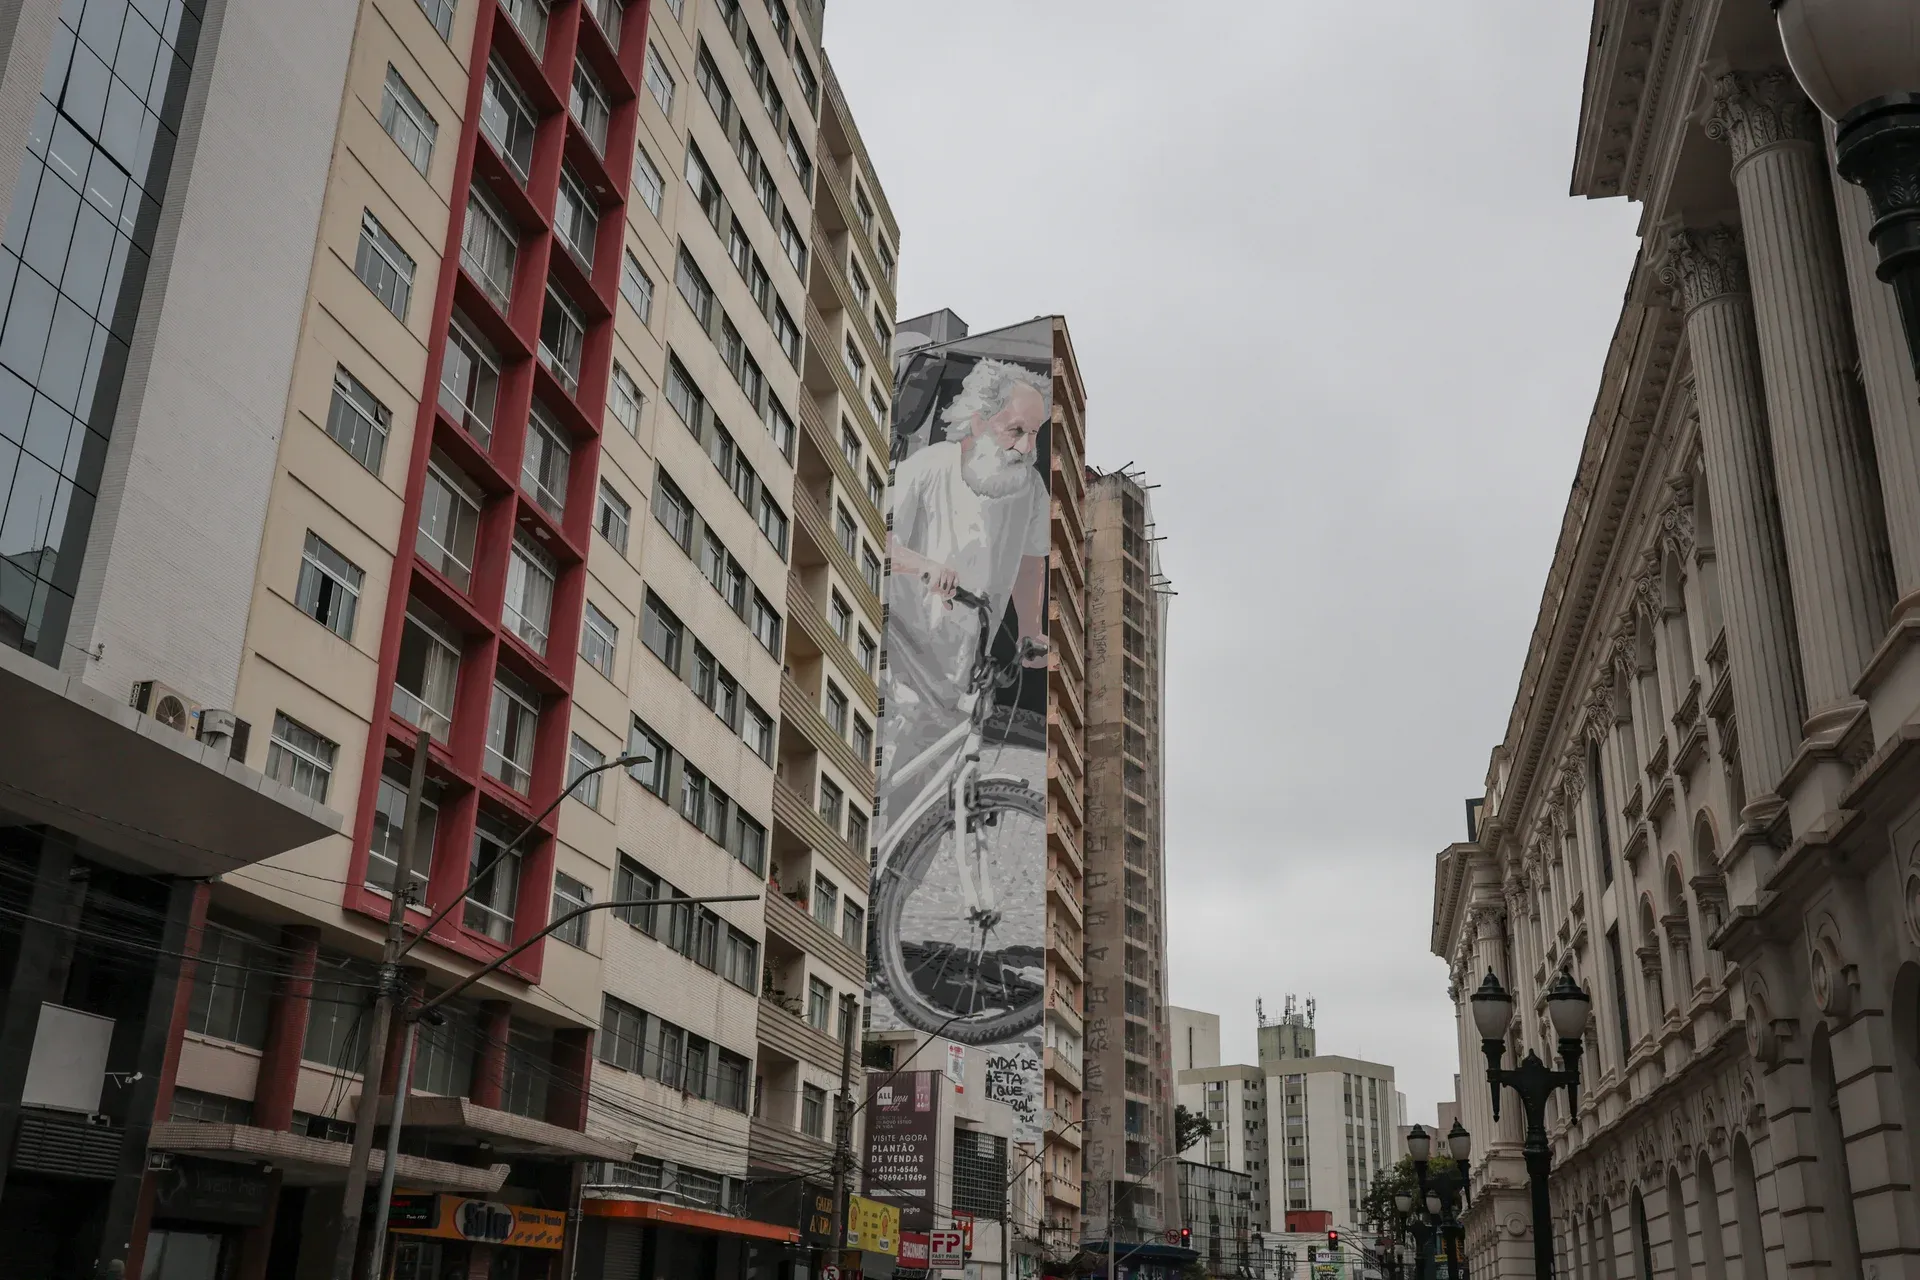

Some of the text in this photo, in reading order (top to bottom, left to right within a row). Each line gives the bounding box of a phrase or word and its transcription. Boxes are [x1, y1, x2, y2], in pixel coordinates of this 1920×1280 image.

[1020, 1059, 1038, 1071] DE
[997, 1086, 1024, 1096] QUE
[878, 1092, 892, 1100] ALL
[872, 1134, 928, 1142] VISITE AGORA
[871, 1142, 915, 1153] PLANTÃO
[871, 1154, 924, 1163] DE VENDAS
[878, 1165, 919, 1173] 4141-6546
[932, 1233, 961, 1253] FP
